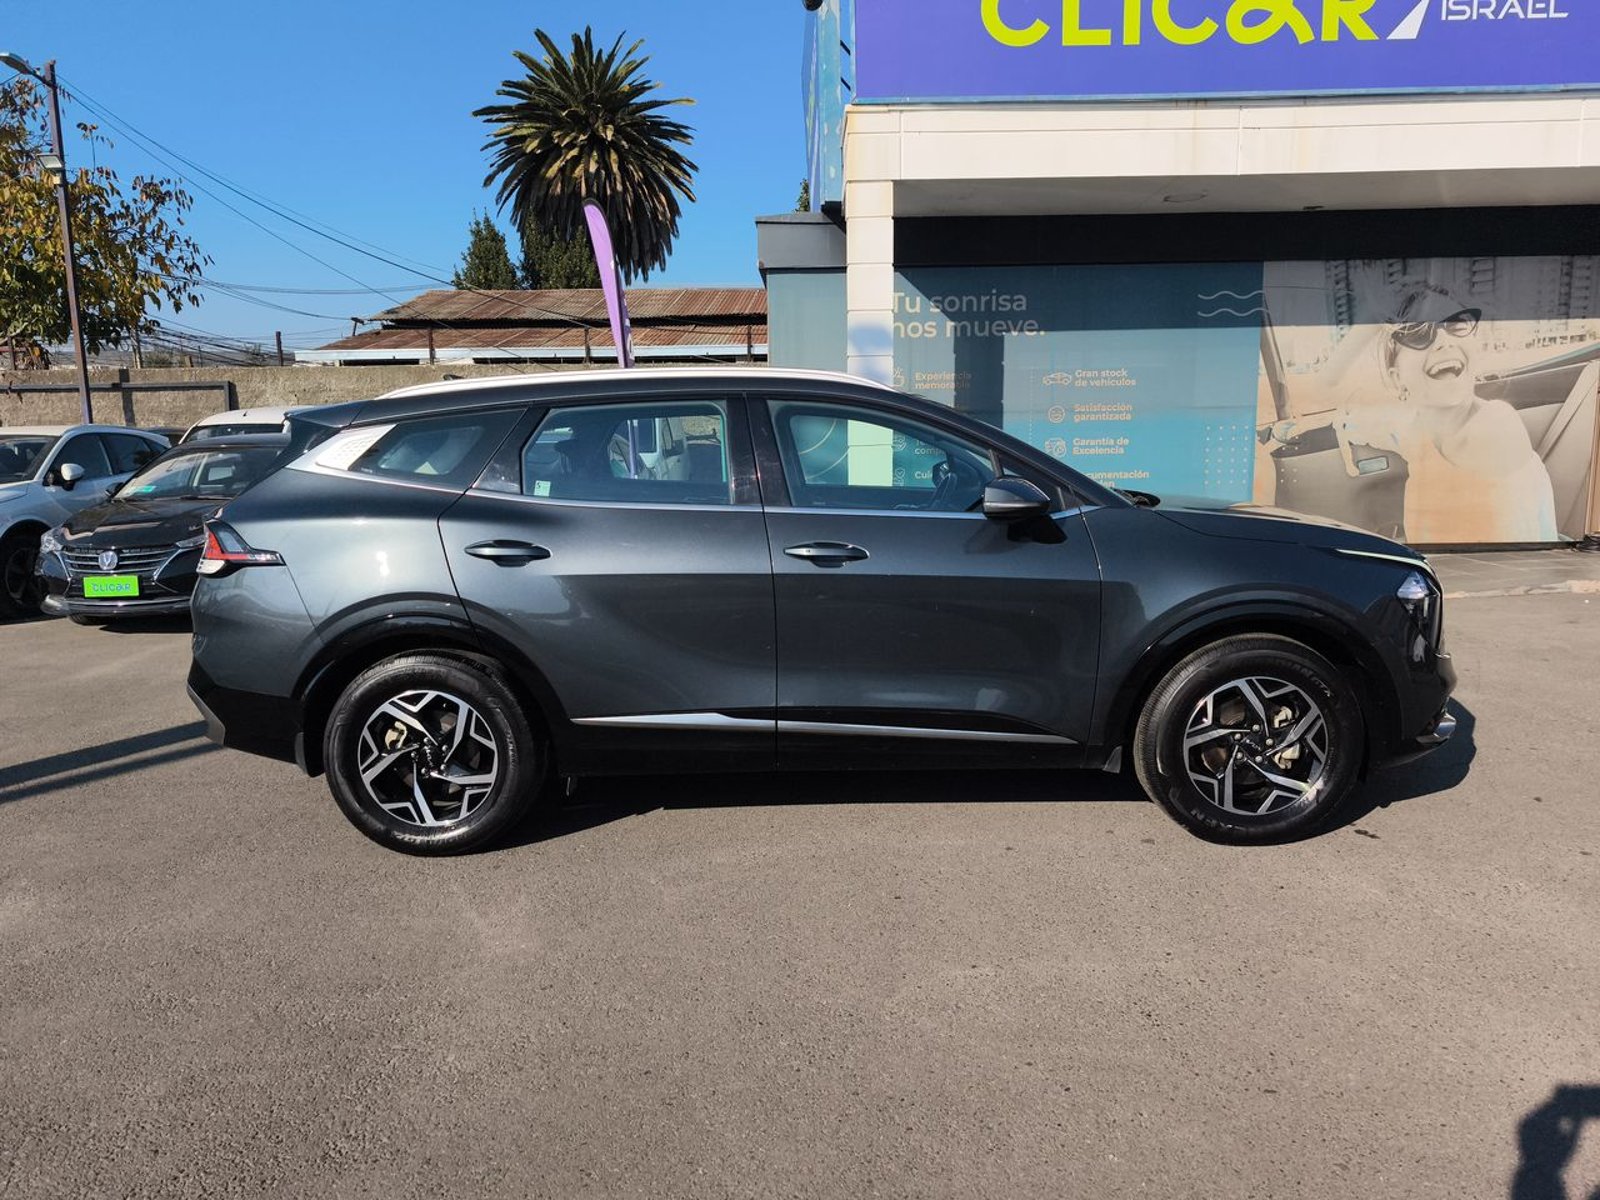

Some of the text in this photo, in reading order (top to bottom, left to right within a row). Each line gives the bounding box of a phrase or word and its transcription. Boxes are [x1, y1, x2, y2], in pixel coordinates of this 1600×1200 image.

[1441, 0, 1569, 20] ISRAEL
[893, 288, 1027, 313] Tu sonrisa
[945, 318, 1046, 338] mueve.
[1075, 367, 1129, 378] Gran stock
[1116, 437, 1130, 446] de
[1072, 446, 1125, 455] Excelencia
